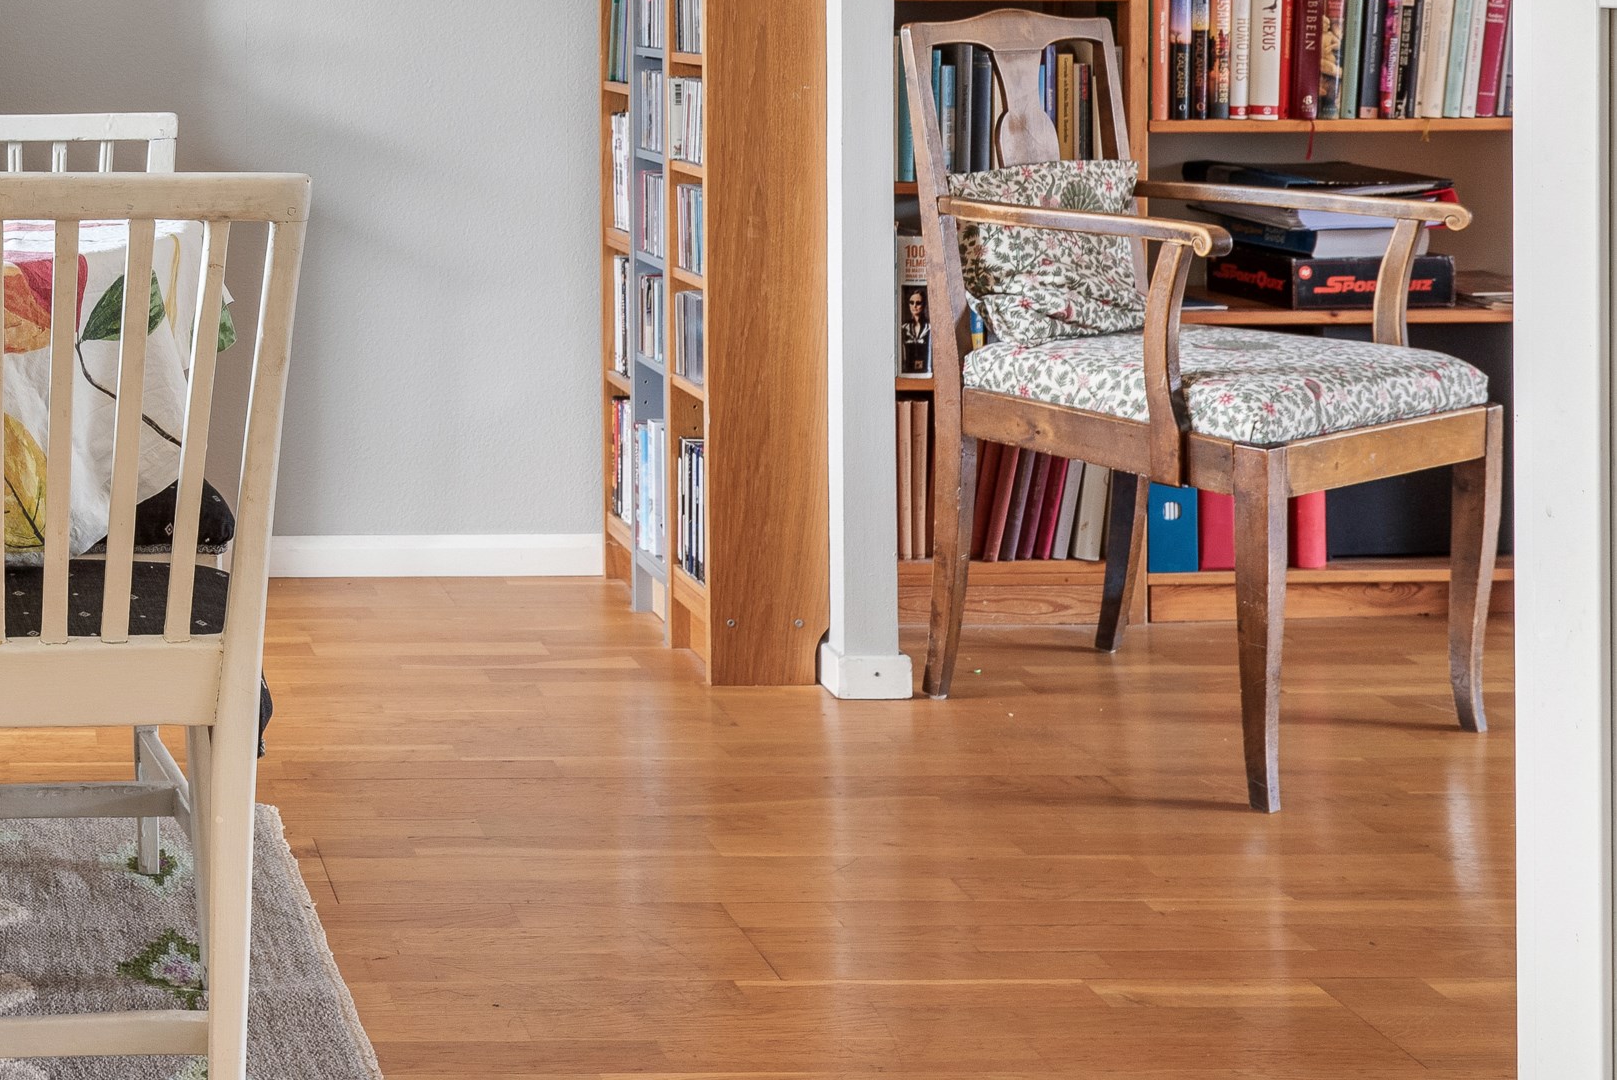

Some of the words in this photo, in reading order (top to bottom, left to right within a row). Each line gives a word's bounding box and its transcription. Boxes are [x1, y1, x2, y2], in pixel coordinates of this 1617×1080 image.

[1236, 18, 1249, 50] HOMO
[1262, 16, 1276, 52] NEXUS
[1305, 0, 1318, 51] BIBELN
[1177, 52, 1185, 98] KALAHARI
[1219, 58, 1228, 82] LASSE
[1236, 54, 1248, 82] DEUS
[1219, 82, 1228, 103] BERG
[1213, 263, 1285, 290] SPORTQUIZ
[1313, 275, 1433, 294] SPORUIZ
